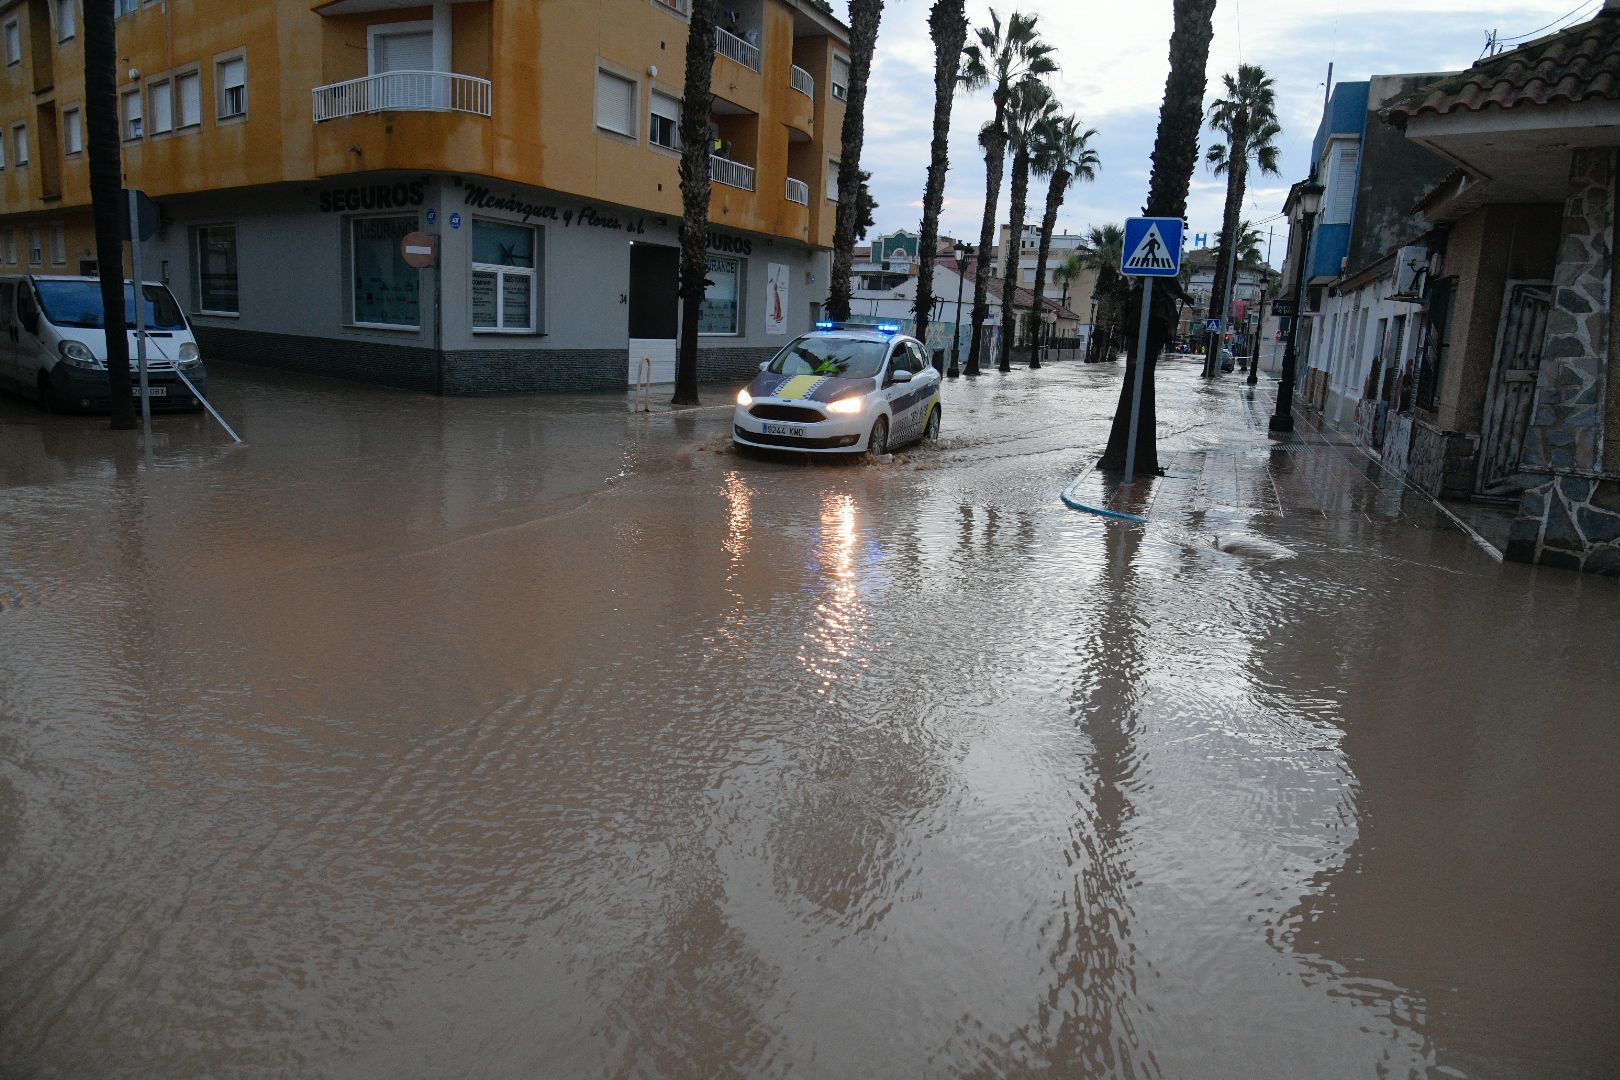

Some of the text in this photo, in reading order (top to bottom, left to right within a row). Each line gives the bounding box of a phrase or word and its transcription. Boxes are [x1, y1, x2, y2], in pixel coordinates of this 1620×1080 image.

[320, 181, 424, 212] SEGUROS
[563, 209, 573, 227] y
[767, 425, 786, 435] 9244
